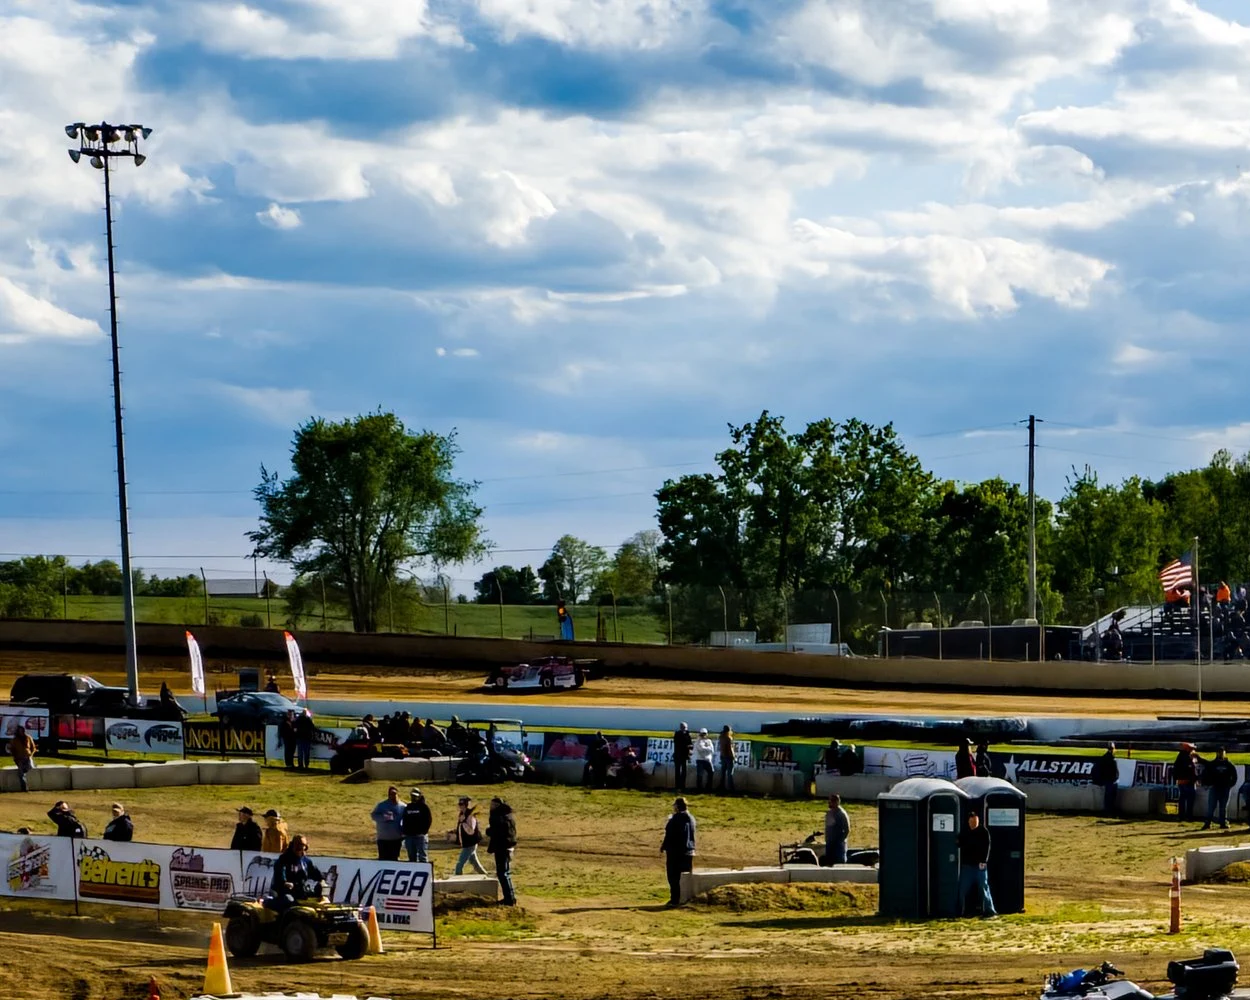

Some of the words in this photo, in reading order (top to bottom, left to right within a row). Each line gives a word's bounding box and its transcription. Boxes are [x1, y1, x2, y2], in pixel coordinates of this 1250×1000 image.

[184, 728, 221, 751] UNOH
[224, 728, 264, 751] UNOH
[1017, 758, 1094, 775] ALLSTAR
[80, 855, 160, 887] Behrent's
[345, 868, 429, 908] MEGA
